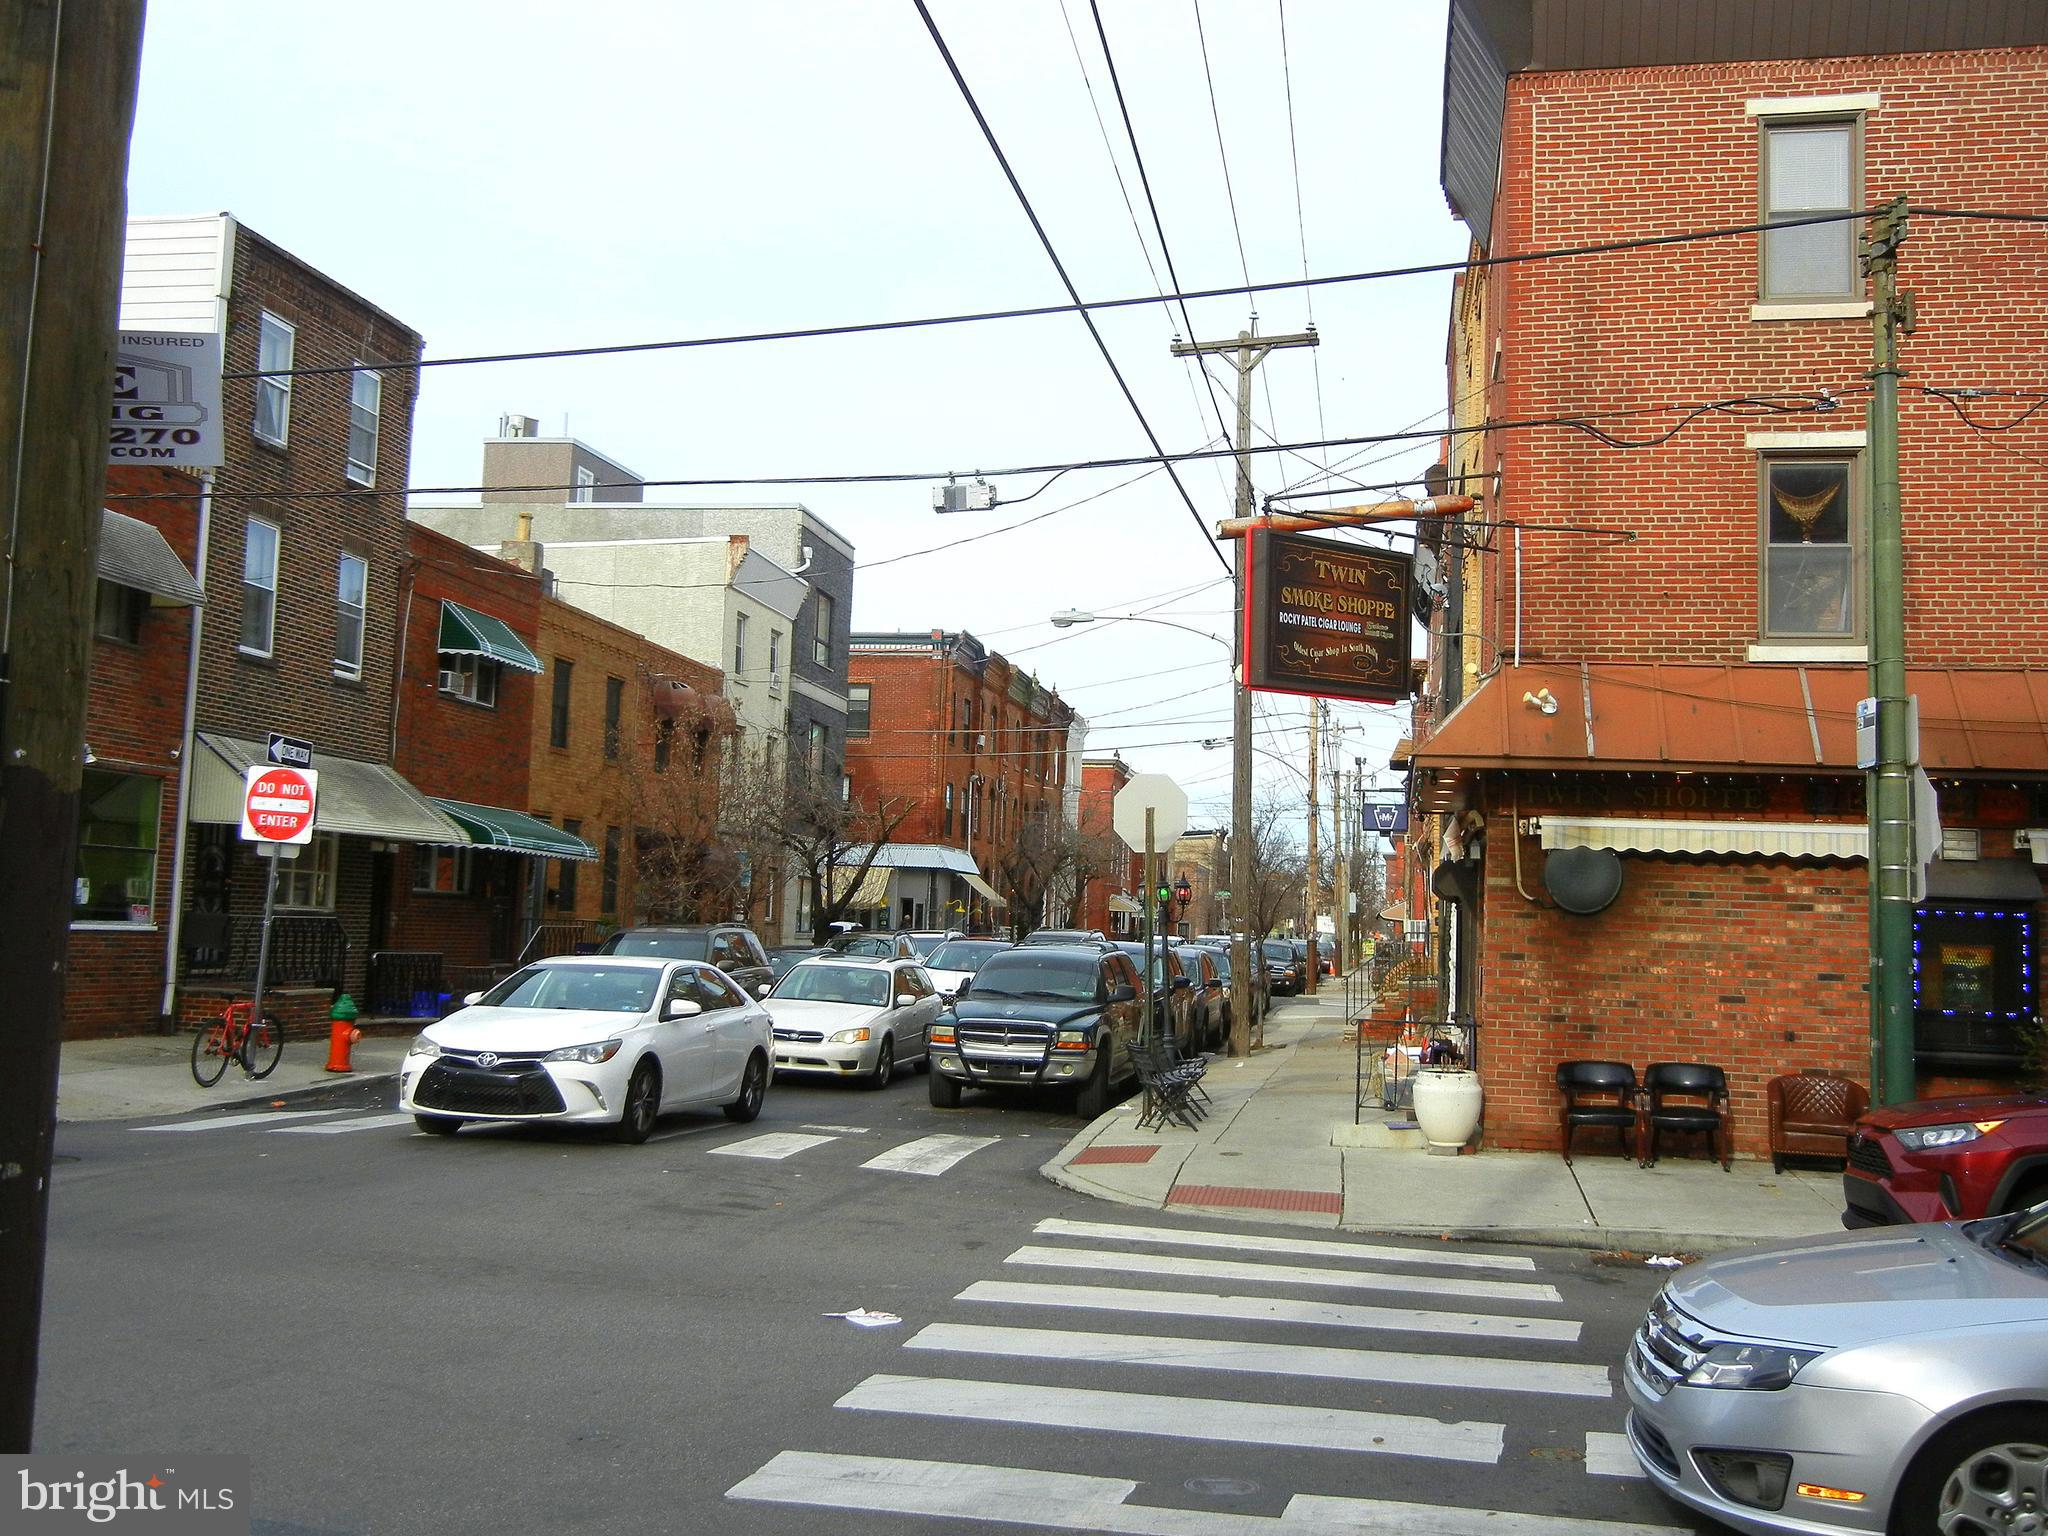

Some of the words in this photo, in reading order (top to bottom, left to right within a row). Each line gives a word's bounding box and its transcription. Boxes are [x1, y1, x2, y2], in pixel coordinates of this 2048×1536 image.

[122, 336, 205, 348] INSURED
[1315, 560, 1367, 585] TWIN
[1281, 586, 1334, 612] SMOKE
[1337, 595, 1395, 619] SHOPPE
[1279, 611, 1301, 626] ROCKY
[1301, 614, 1318, 628] PATEL
[1318, 617, 1338, 631] CIGAR
[1338, 619, 1362, 634] LOUNGE
[1325, 646, 1340, 656] Shop
[283, 745, 295, 759] ONE
[258, 782, 276, 794] DO
[282, 783, 306, 796] NOT
[1632, 785, 1763, 811] SHOPPE
[259, 813, 298, 828] ENTER
